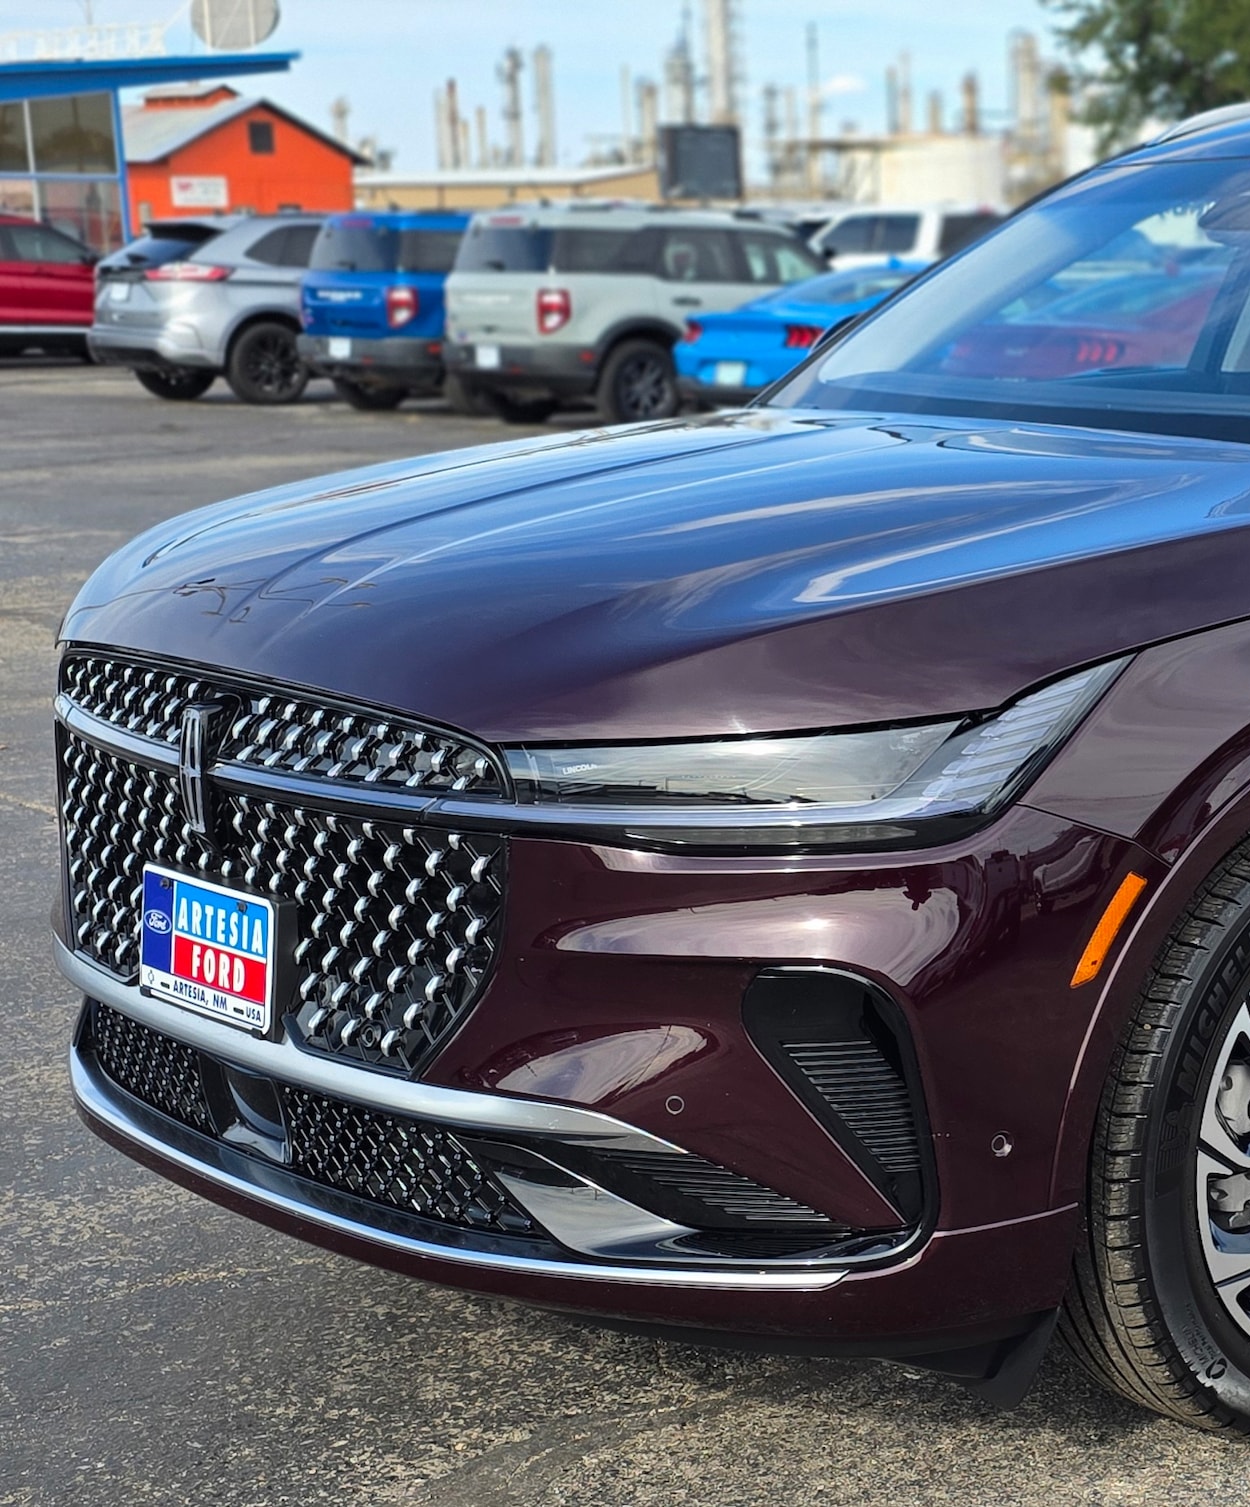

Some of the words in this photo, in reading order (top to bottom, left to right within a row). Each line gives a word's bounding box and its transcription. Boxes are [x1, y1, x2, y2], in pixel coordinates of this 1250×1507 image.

[177, 897, 264, 955] ARTESIA
[191, 944, 246, 993] FORD
[172, 980, 210, 1005] ARTESIA,
[212, 993, 228, 1011] NM
[245, 1007, 262, 1022] USA
